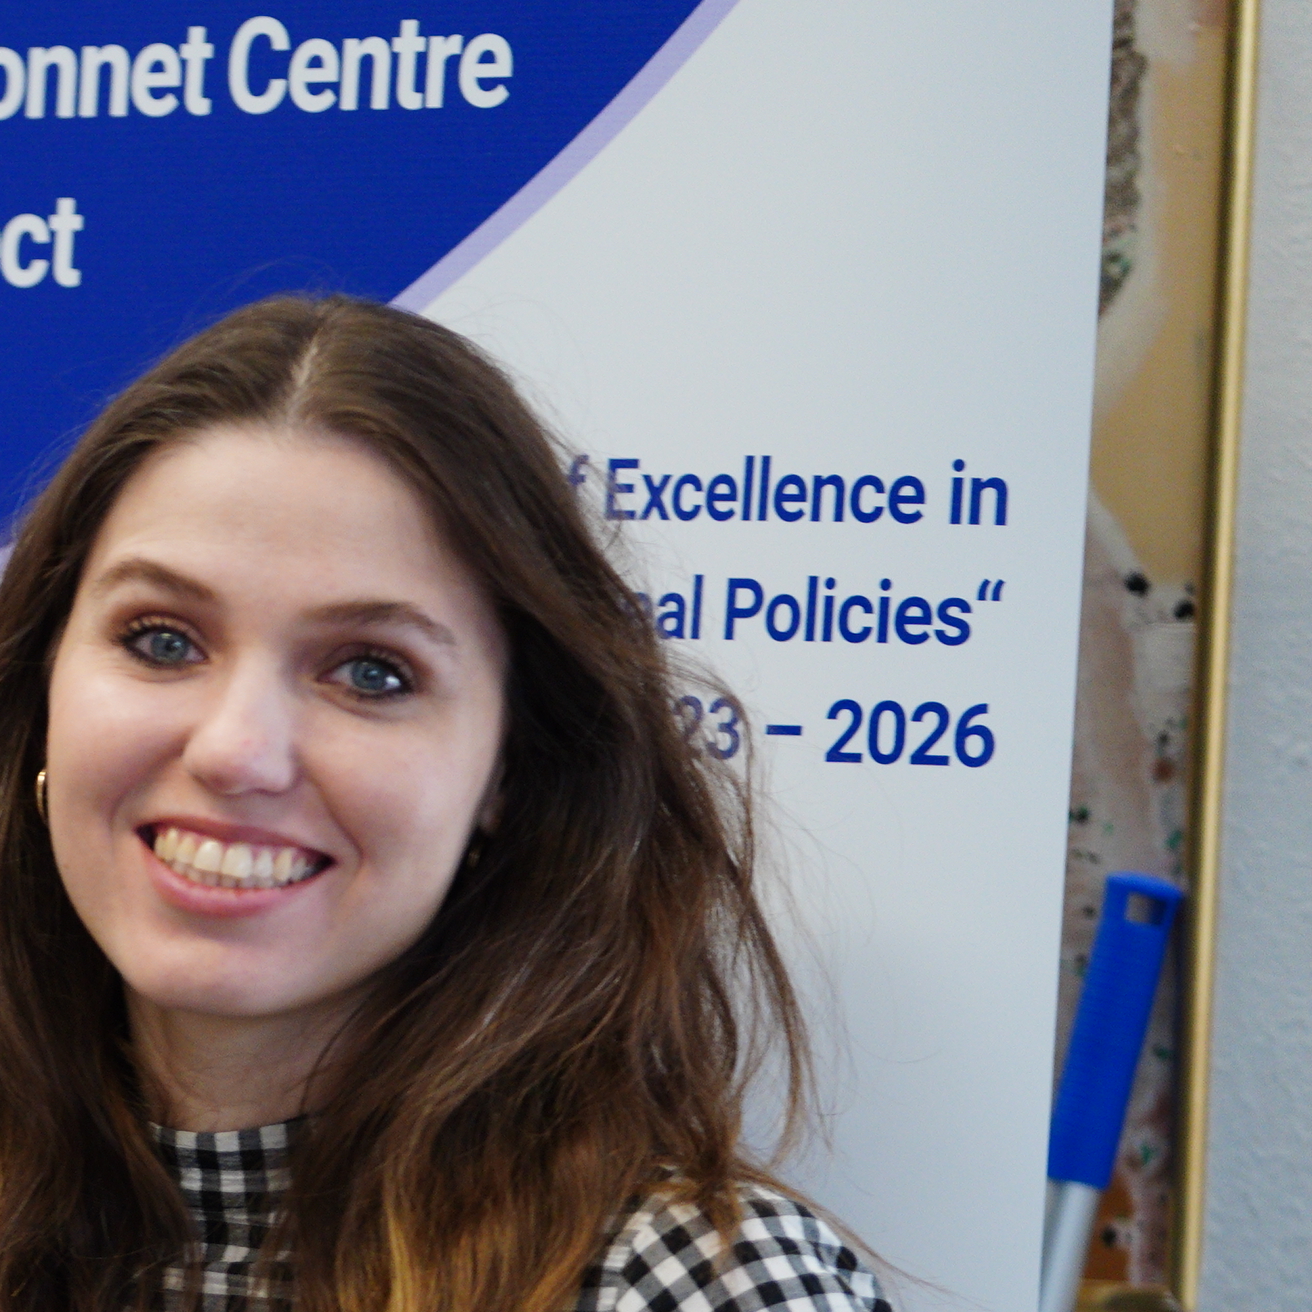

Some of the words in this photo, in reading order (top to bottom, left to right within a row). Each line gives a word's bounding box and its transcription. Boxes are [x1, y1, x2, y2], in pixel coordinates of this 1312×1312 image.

[228, 15, 513, 115] Centre
[605, 454, 926, 525] Excellence
[949, 458, 1008, 526] in
[824, 698, 996, 768] 2026
